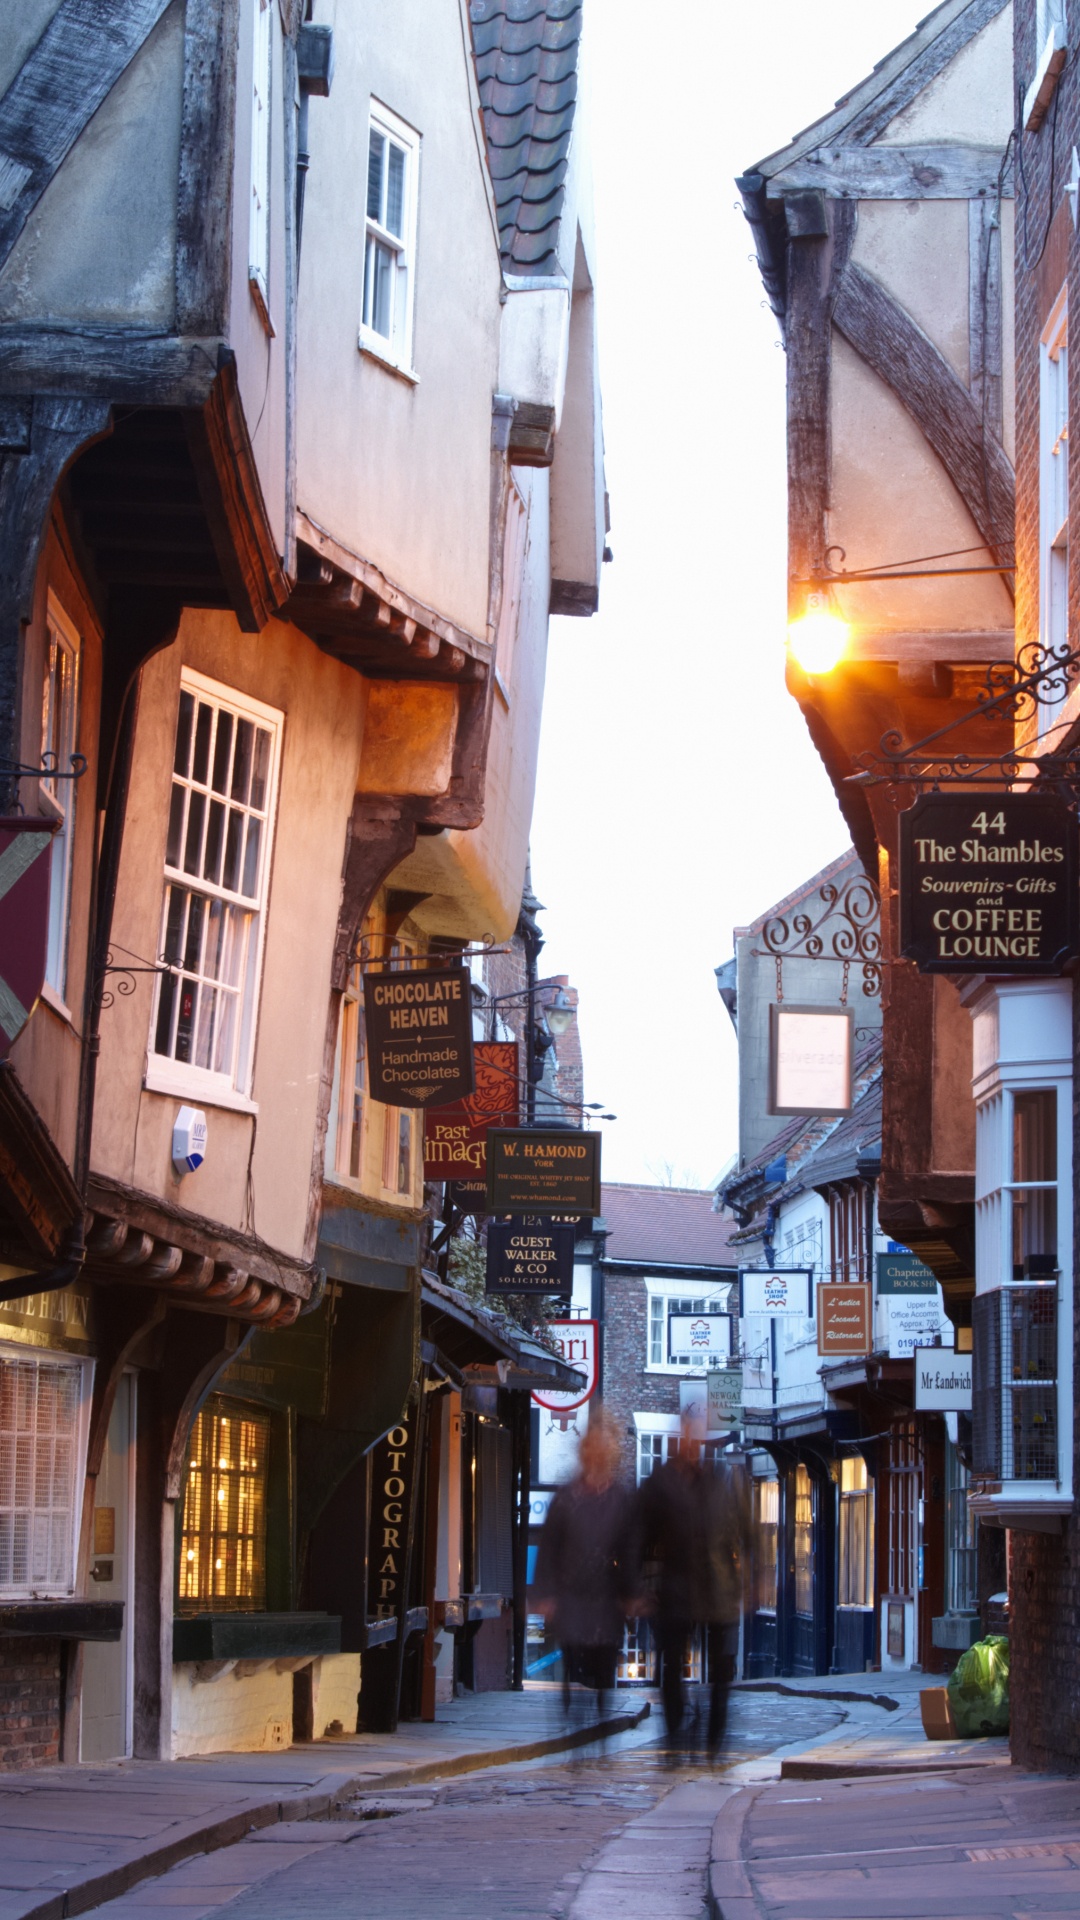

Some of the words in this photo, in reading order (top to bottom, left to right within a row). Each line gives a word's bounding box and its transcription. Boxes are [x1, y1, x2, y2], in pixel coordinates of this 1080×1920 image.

[971, 811, 1007, 835] 44
[914, 839, 957, 863] The
[961, 839, 1064, 863] Shambles
[976, 896, 1003, 906] and
[933, 909, 1043, 932] COFFEE
[939, 936, 1041, 957] LOUNGE
[375, 980, 461, 1005] CHOCOLATE
[389, 1006, 449, 1029] HEAVEN
[381, 1048, 458, 1066] Handmade
[381, 1065, 461, 1083] Chocolates
[435, 1125, 470, 1140] Past
[503, 1141, 519, 1157] W.
[524, 1144, 587, 1159] HAMOND
[510, 1194, 577, 1202] www.whamond.com
[510, 1236, 552, 1247] GUEST
[505, 1249, 557, 1261] WALKER
[514, 1263, 524, 1273] &
[527, 1263, 547, 1274] CO
[887, 1267, 935, 1279] Chapterho
[498, 1276, 562, 1285] SOLICITORS
[893, 1280, 919, 1288] BOOK
[828, 1314, 860, 1324] Locanda
[890, 1311, 909, 1319] Office
[825, 1331, 864, 1340] Ristorante
[921, 1371, 933, 1389] Mr
